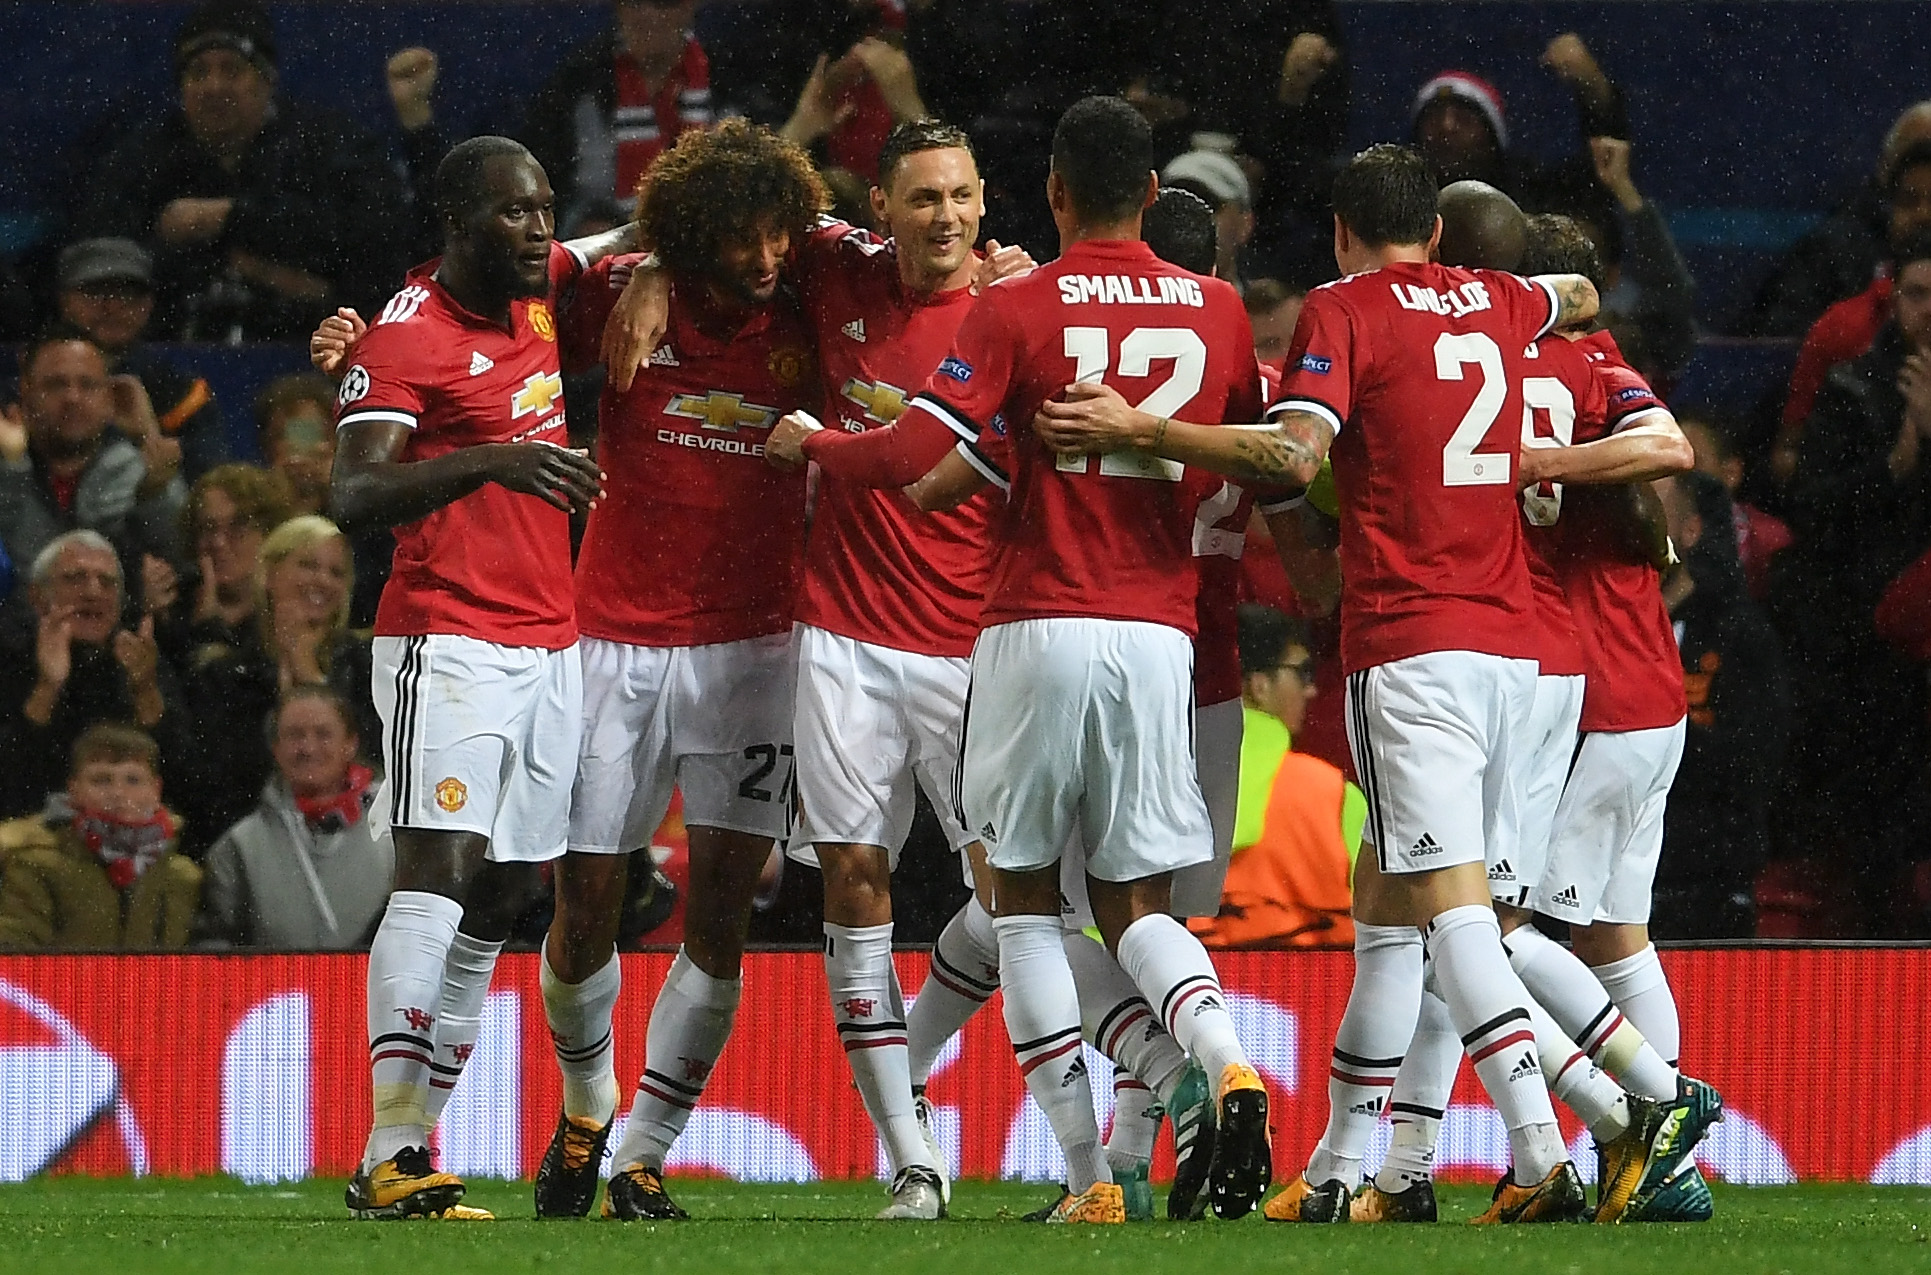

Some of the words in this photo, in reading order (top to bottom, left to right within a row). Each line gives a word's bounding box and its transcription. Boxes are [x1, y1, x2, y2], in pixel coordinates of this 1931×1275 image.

[1058, 274, 1204, 308] SMALLING
[1433, 331, 1511, 487] 2
[657, 430, 765, 458] CHEVROLE
[1409, 846, 1443, 857] adidas
[1552, 895, 1580, 908] adidas
